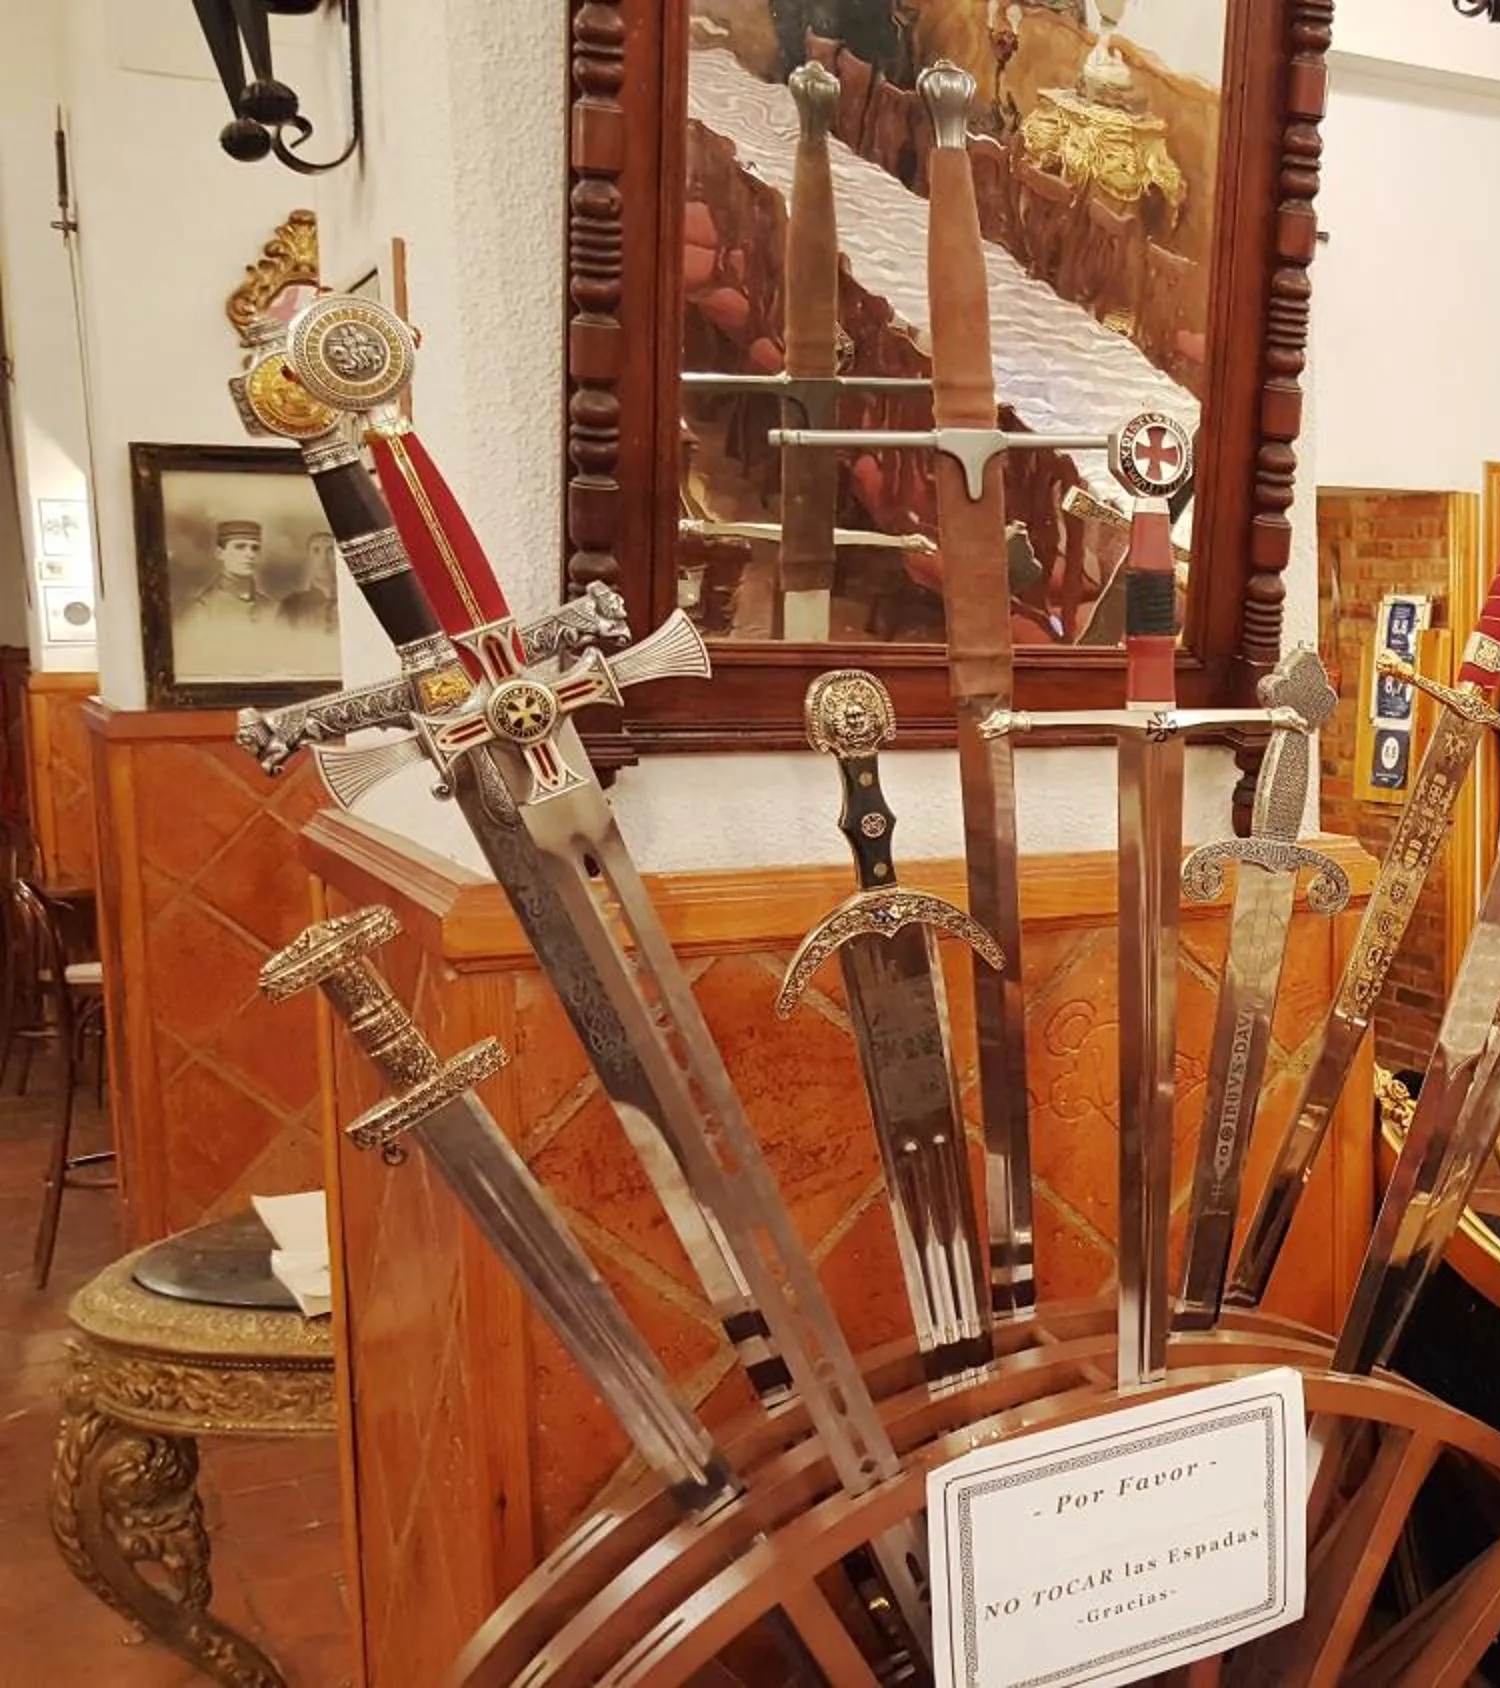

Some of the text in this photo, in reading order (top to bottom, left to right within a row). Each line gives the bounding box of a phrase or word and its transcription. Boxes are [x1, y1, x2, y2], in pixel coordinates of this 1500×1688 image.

[1056, 1489, 1105, 1514] Por
[1118, 1462, 1199, 1496] Favor
[984, 1528, 1260, 1621] NO TOCAR las Espadas
